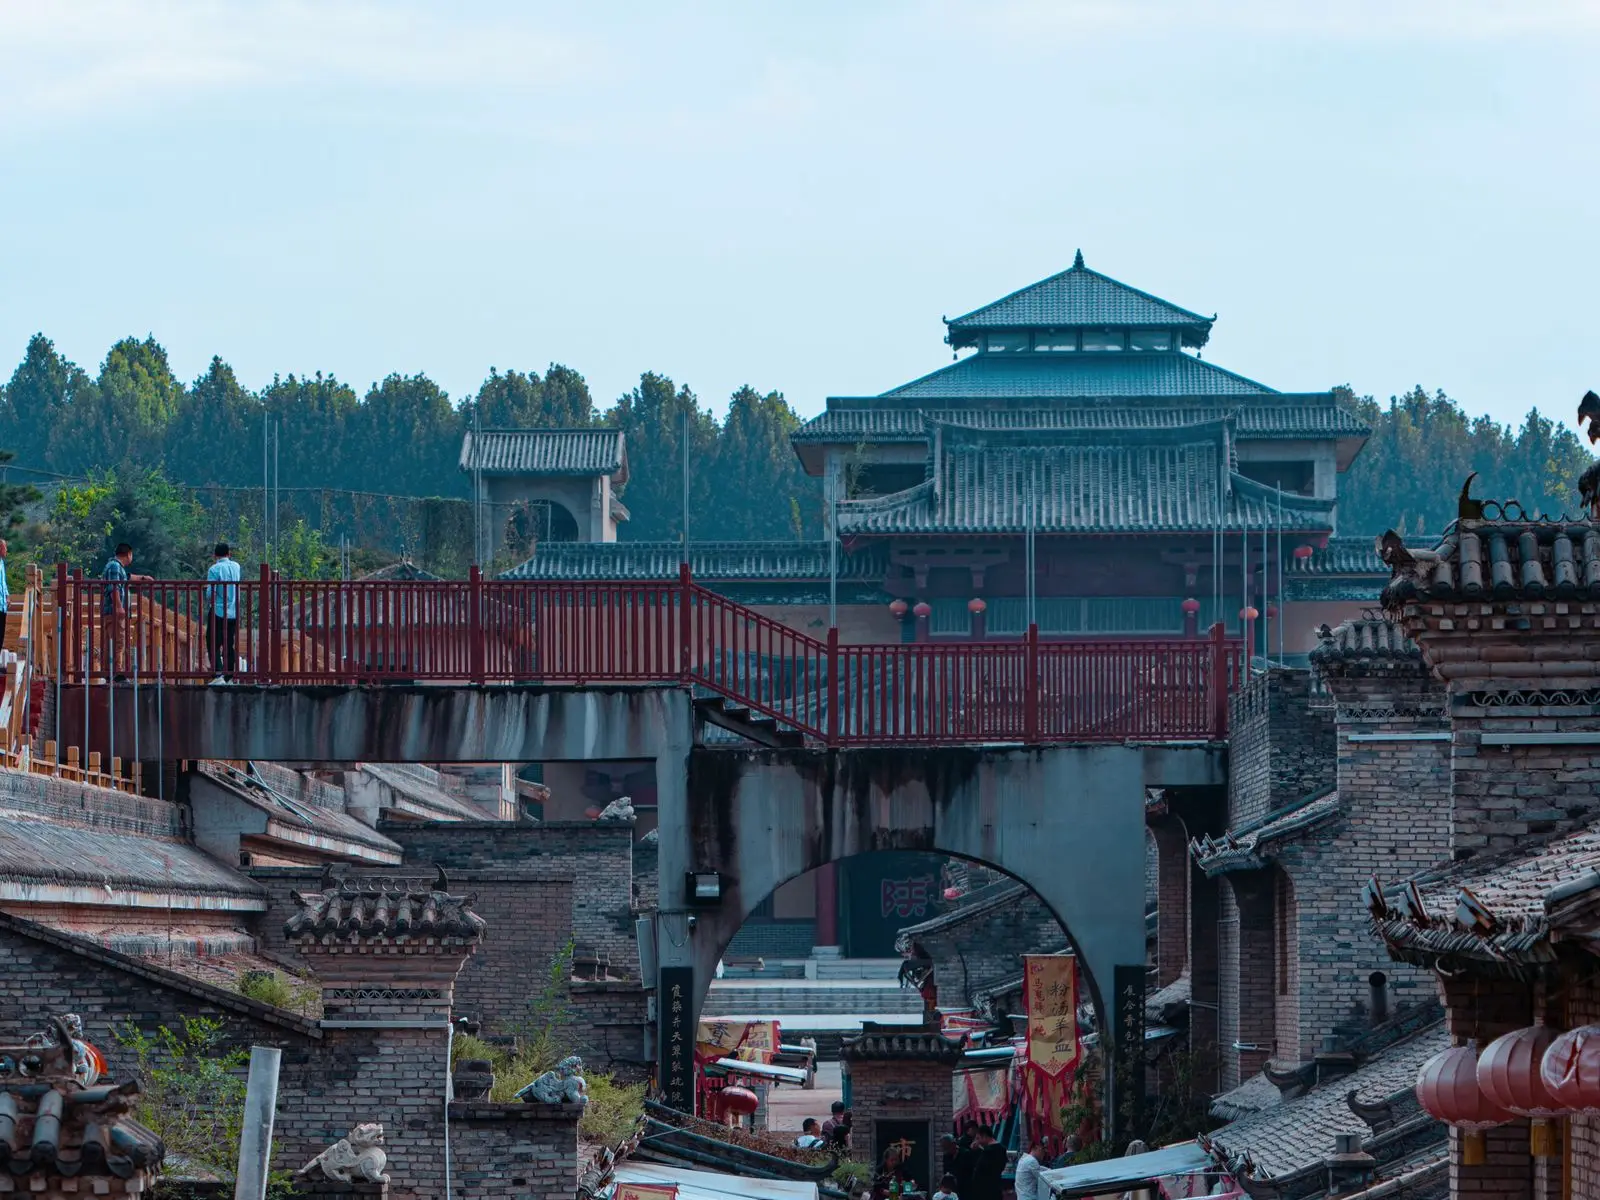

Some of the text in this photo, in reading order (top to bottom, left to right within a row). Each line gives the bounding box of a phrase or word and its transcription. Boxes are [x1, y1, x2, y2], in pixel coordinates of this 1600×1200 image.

[881, 878, 947, 918] 陕
[1049, 981, 1072, 1054] 粉汤羊血
